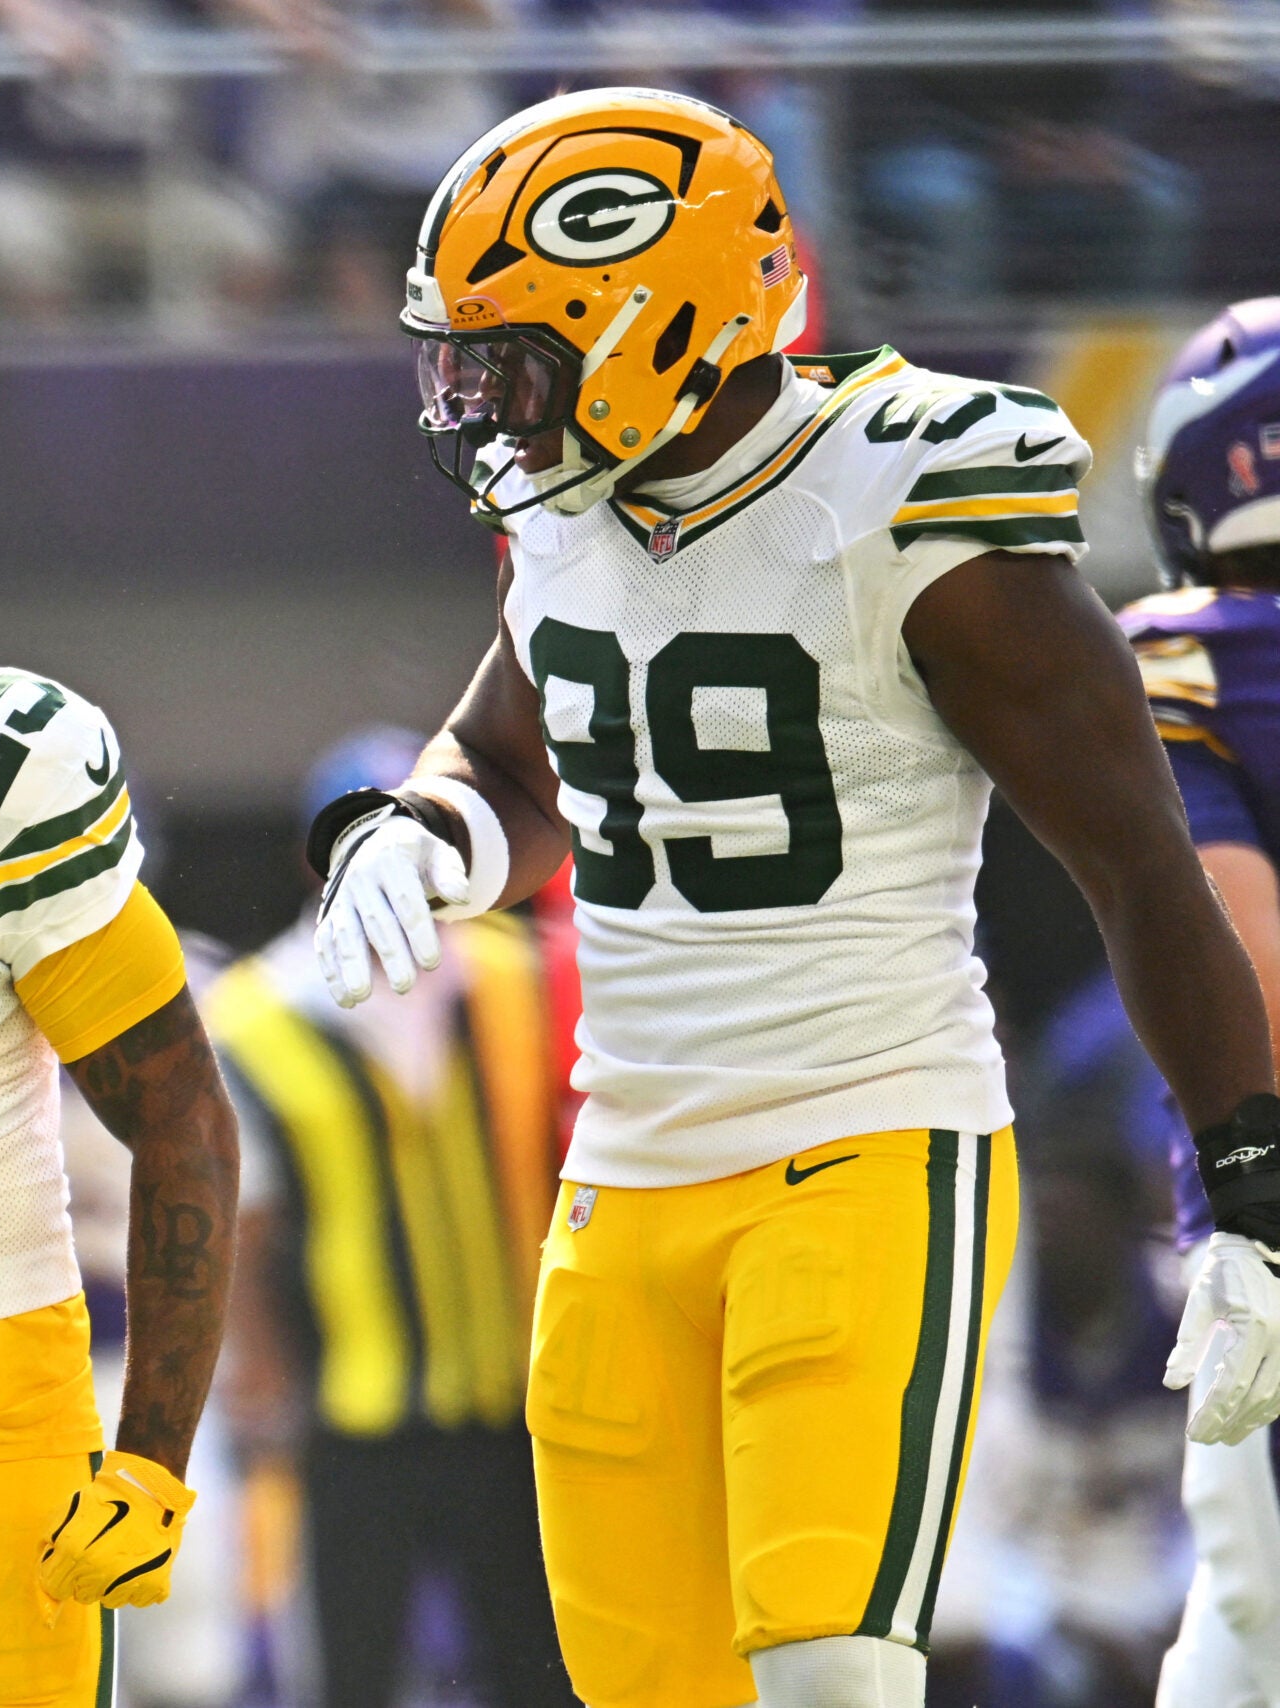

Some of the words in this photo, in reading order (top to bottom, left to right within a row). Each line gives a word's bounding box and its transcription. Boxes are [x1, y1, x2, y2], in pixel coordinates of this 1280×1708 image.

[531, 174, 669, 260] G
[453, 312, 496, 324] OAKLEY
[529, 616, 843, 913] 99
[338, 809, 383, 844] ADIZERO
[1216, 1146, 1269, 1168] DONJOY
